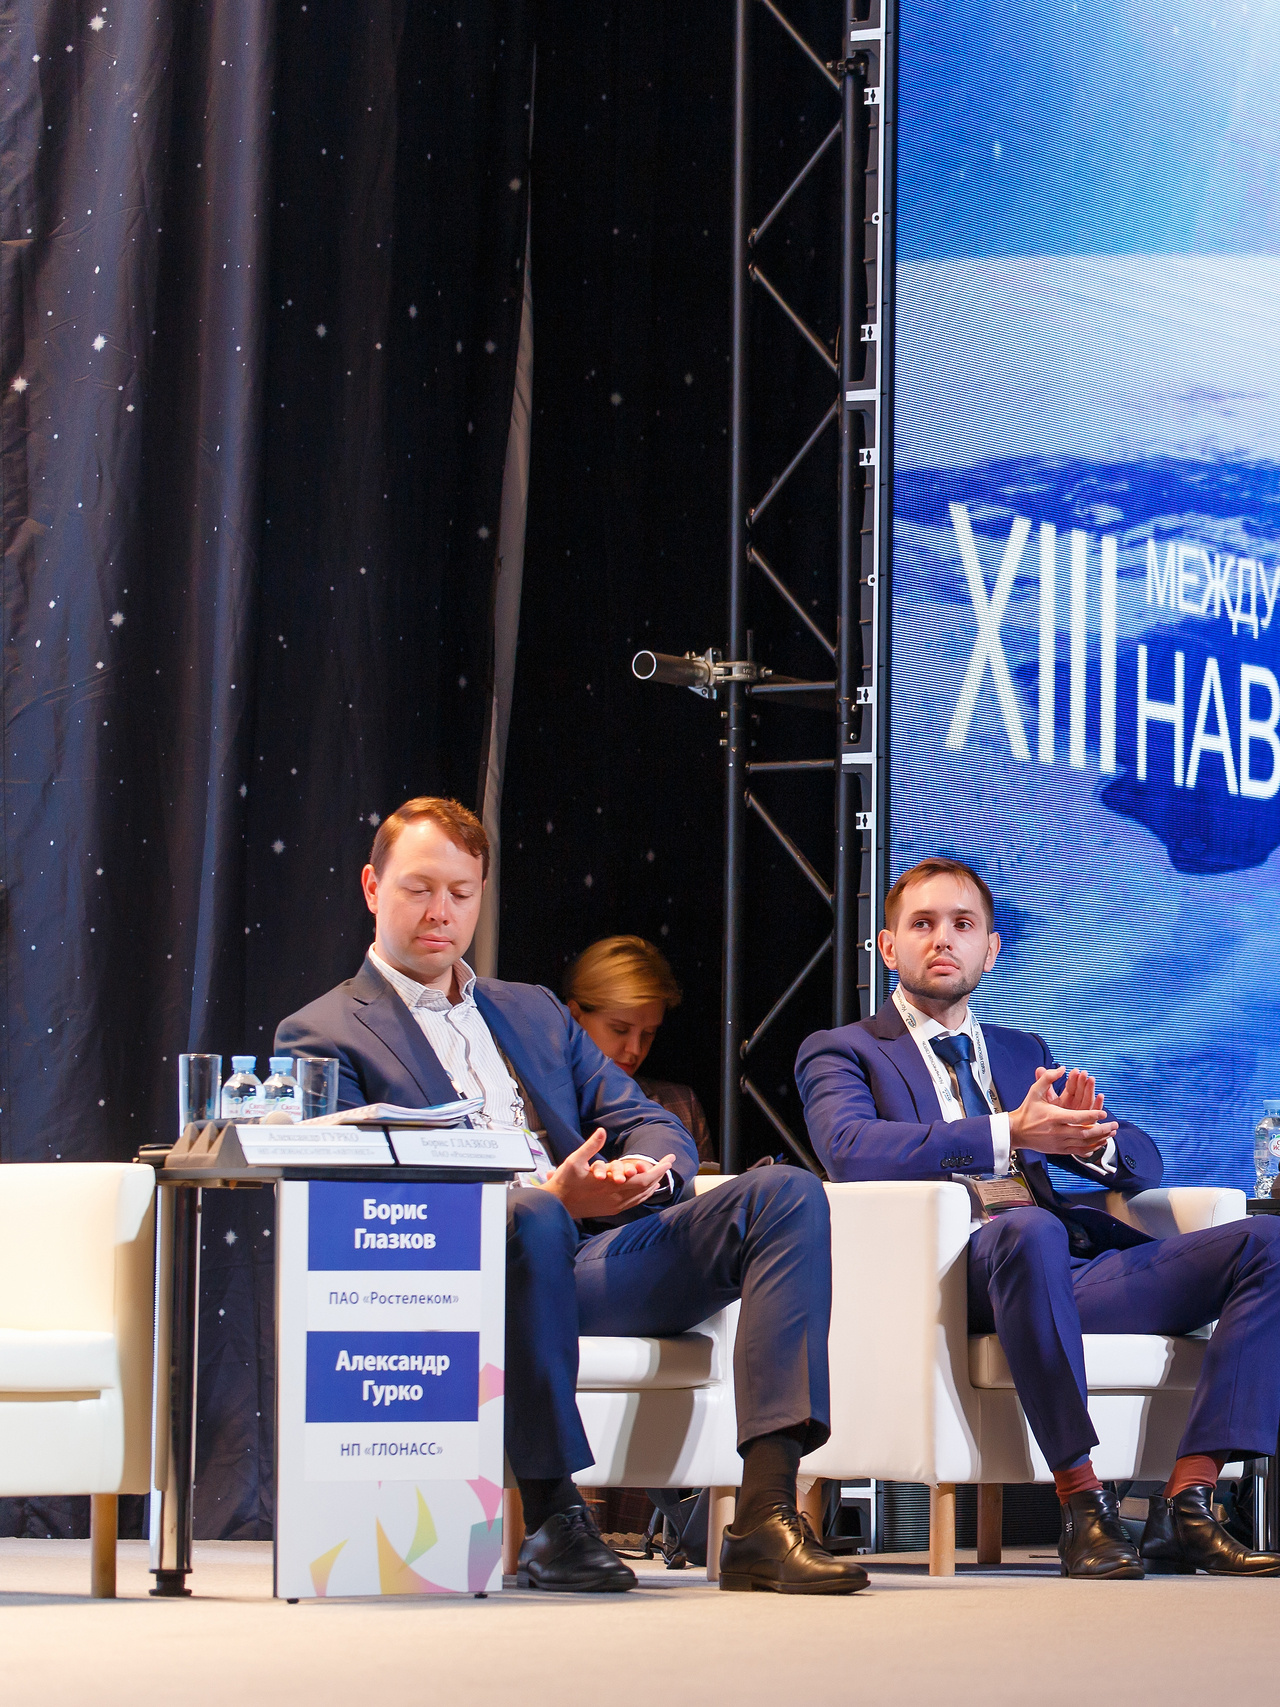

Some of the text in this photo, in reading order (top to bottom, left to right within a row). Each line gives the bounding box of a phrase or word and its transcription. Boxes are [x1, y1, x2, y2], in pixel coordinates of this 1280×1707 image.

[945, 502, 1118, 773] XIII
[420, 1137, 499, 1149] Борис ГЛАЗКОВ
[363, 1198, 427, 1225] Борис
[354, 1227, 436, 1250] Глазков
[329, 1291, 459, 1305] ПАО «Ростелеком»
[335, 1350, 450, 1376] Александр
[362, 1380, 424, 1407] Гурко
[340, 1442, 443, 1457] НП «ГЛОНАСС»
